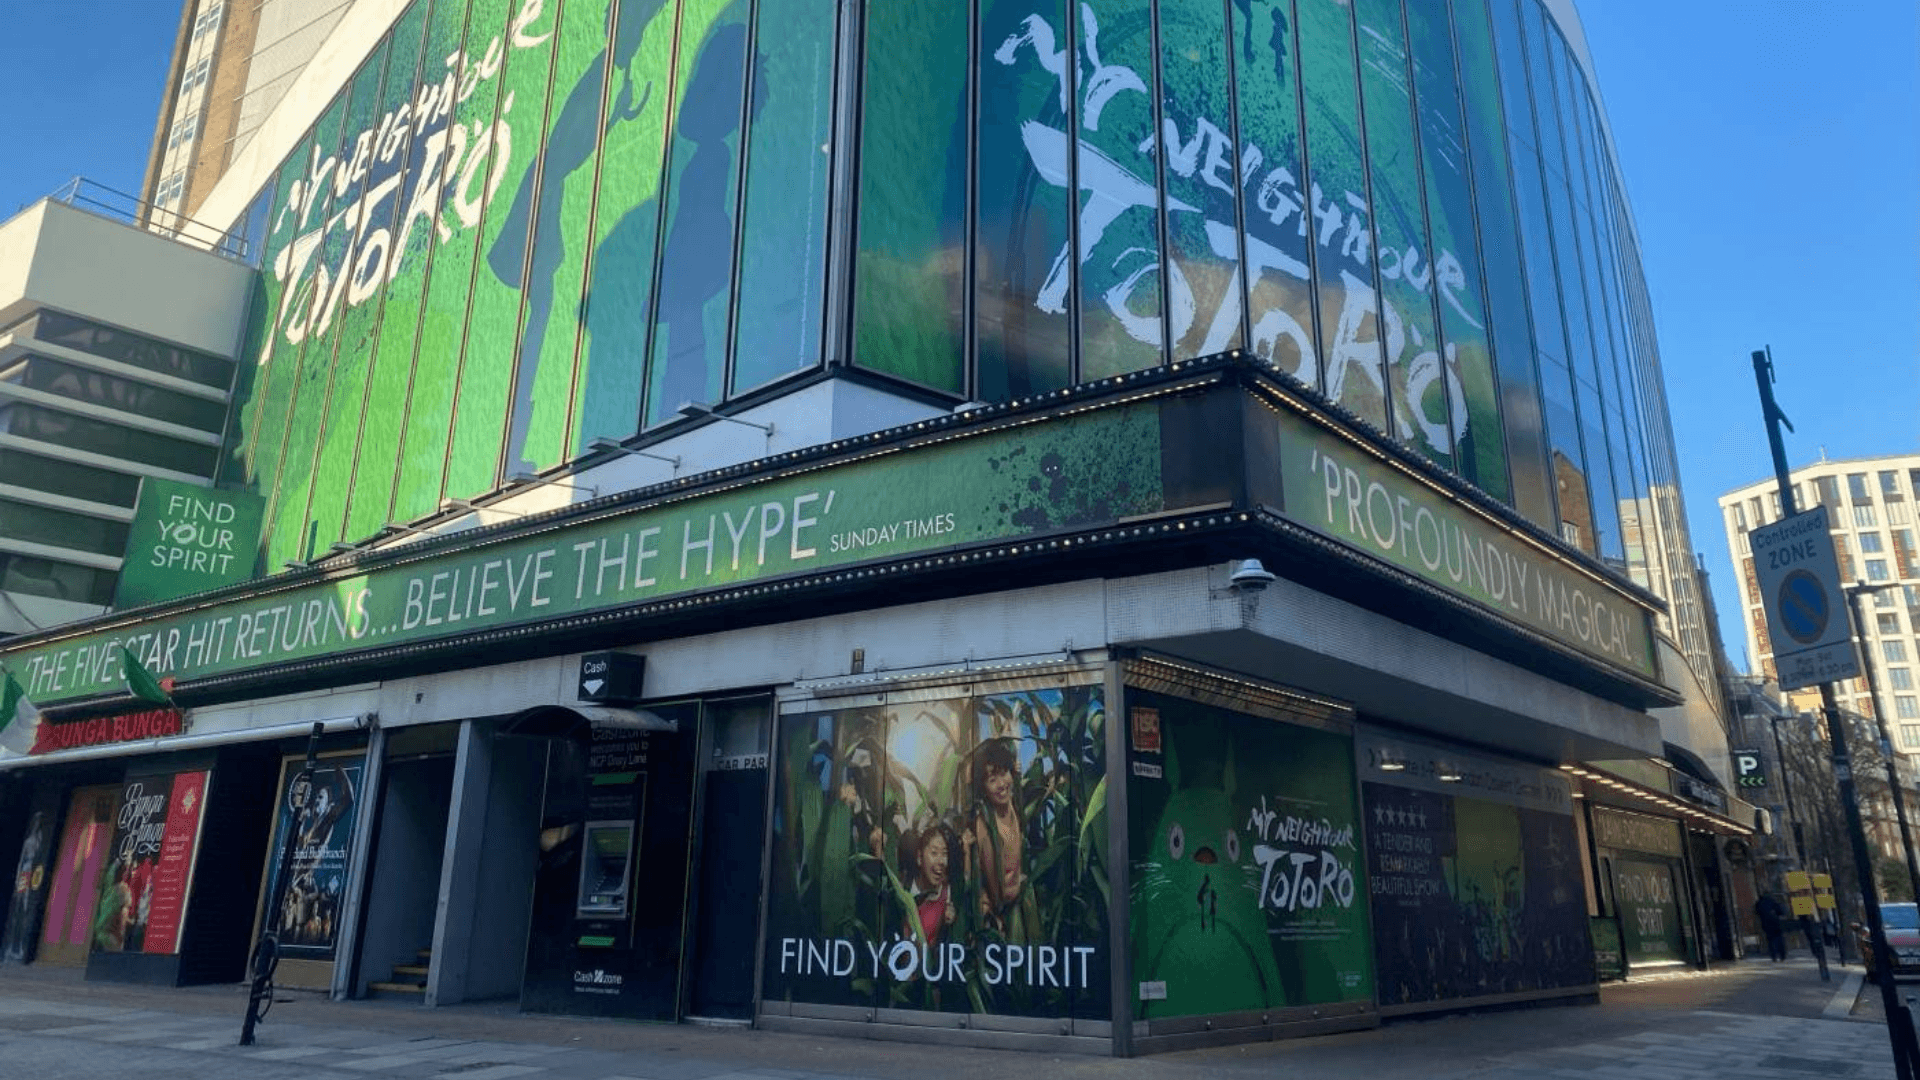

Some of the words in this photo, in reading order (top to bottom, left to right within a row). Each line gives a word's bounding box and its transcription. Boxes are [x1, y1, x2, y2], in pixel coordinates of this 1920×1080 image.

[994, 2, 1148, 131] MY
[1138, 117, 1485, 331] NEIGHBOUR
[167, 494, 236, 524] FIND
[157, 518, 234, 551] YOUR
[830, 522, 899, 553] SUNDAY
[904, 512, 956, 540] TIMES
[1755, 514, 1823, 550] Controlled
[151, 547, 234, 575] SPIRIT
[1768, 539, 1818, 570] ZONE
[71, 641, 118, 688] FIVE
[183, 618, 232, 669] HIT
[402, 550, 555, 631] BELIEVE
[573, 527, 661, 600] THE
[680, 490, 835, 580] HYPE'
[583, 660, 607, 674] Cash
[52, 717, 107, 748] UNGA
[113, 708, 175, 741] BUNGA
[744, 756, 768, 772] PAR
[1739, 756, 1758, 775] P
[782, 938, 855, 977] FIND
[867, 933, 967, 983] YOUR
[984, 943, 1096, 989] SPIRIT
